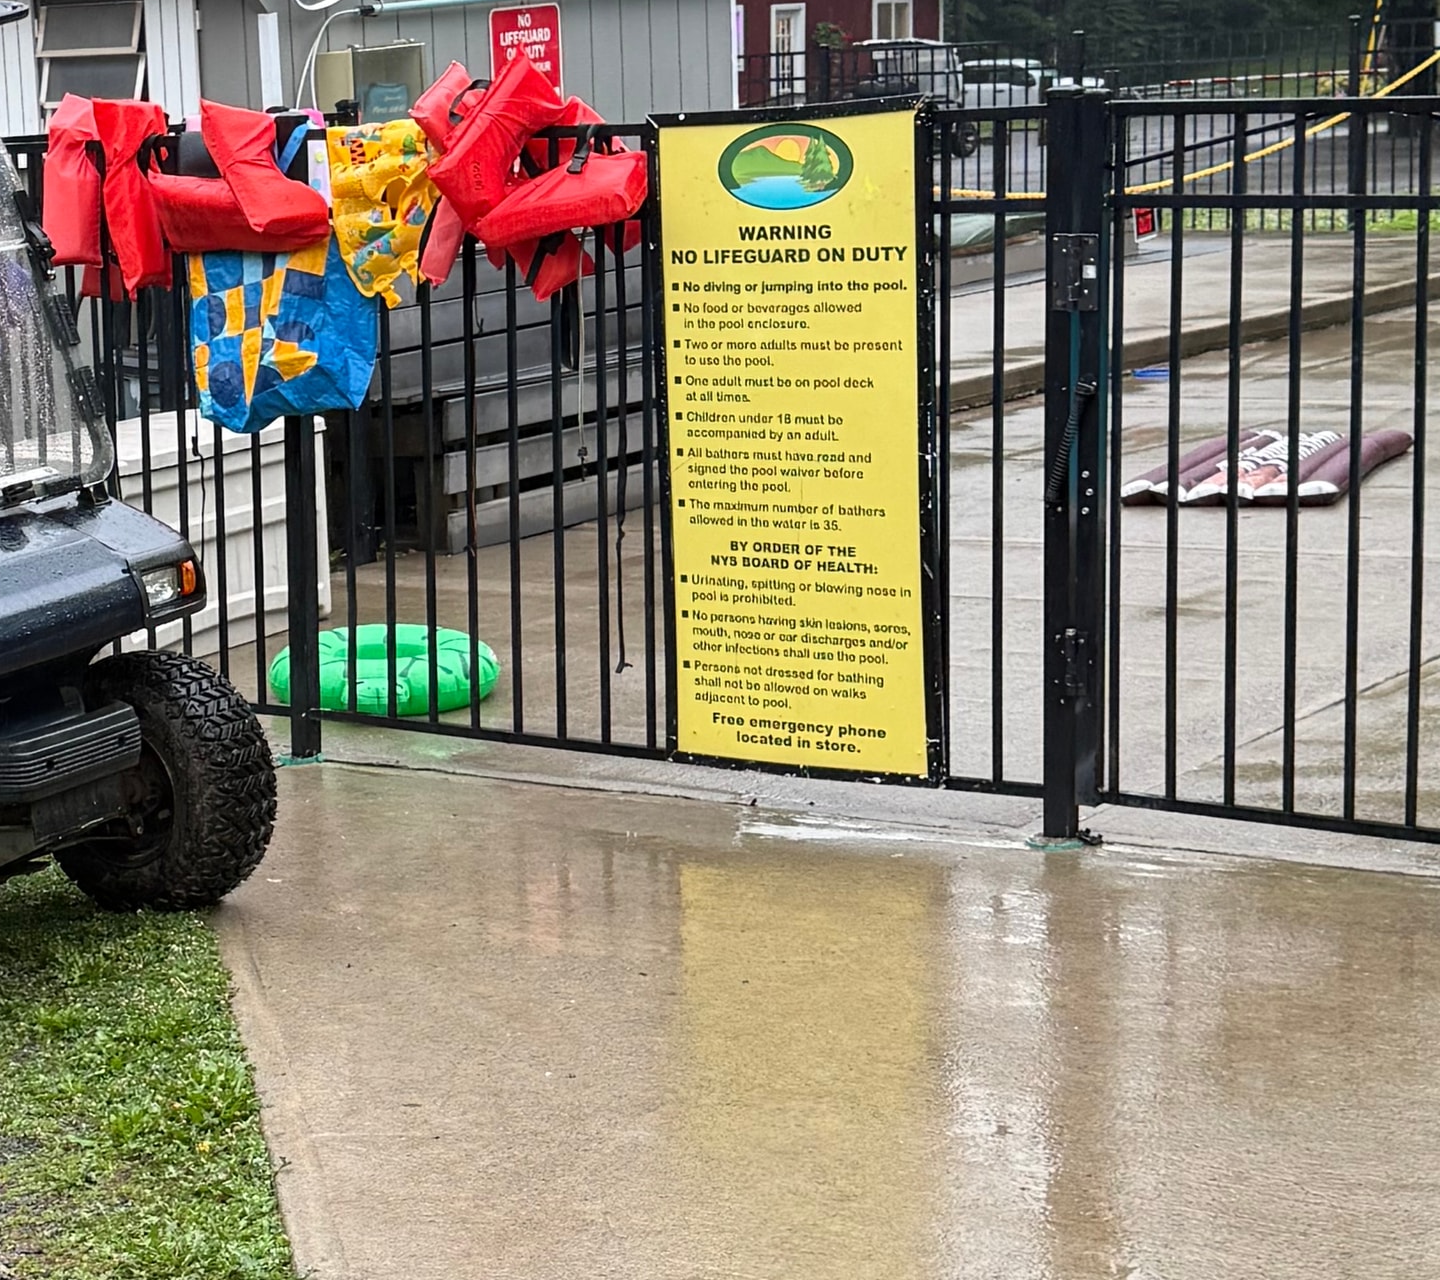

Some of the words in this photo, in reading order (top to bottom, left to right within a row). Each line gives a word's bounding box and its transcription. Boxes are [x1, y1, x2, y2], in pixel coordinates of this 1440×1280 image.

[517, 13, 532, 28] NO
[500, 27, 552, 47] LIFEGUARD
[738, 224, 832, 242] WARNING
[671, 249, 698, 265] NO
[703, 248, 811, 265] LIFEGUARD
[816, 247, 845, 263] ON
[852, 245, 908, 262] DUTY
[683, 281, 701, 293] No
[703, 281, 741, 295] diving
[744, 283, 759, 292] or
[760, 280, 814, 295] jumping
[817, 280, 844, 292] into
[847, 280, 869, 292] the
[873, 279, 908, 294] pool.
[683, 302, 700, 314] No
[702, 302, 729, 314] food
[731, 304, 744, 314] or
[747, 302, 810, 316] beverages
[813, 301, 862, 313] allowed
[684, 318, 695, 329] in
[697, 318, 716, 329] the
[718, 318, 744, 332] pool
[747, 318, 810, 329] enclosure.
[684, 338, 709, 350] Two
[710, 341, 723, 350] or
[726, 341, 757, 350] more
[760, 339, 798, 351] adults
[800, 340, 831, 351] must
[833, 339, 850, 351] be
[853, 339, 903, 353] present
[684, 354, 697, 366] to
[699, 356, 720, 366] use
[722, 354, 742, 366] the
[744, 355, 775, 368] pool.
[685, 375, 709, 387] One
[712, 375, 742, 387] adult
[744, 376, 775, 388] must
[776, 376, 792, 388] be
[794, 378, 810, 388] on
[813, 376, 841, 391] pool
[843, 376, 874, 389] deck
[685, 391, 698, 402] at
[699, 390, 713, 402] all
[686, 411, 736, 423] Children
[738, 412, 774, 424] under
[794, 414, 825, 426] must
[827, 414, 844, 426] be
[687, 428, 766, 441] accompanied
[769, 429, 784, 443] by
[786, 431, 802, 441] an
[687, 447, 703, 458] All
[705, 447, 750, 460] bathers
[752, 450, 783, 462] must
[785, 450, 814, 462] have
[816, 451, 845, 463] read
[848, 452, 872, 464] and
[687, 462, 727, 476] signed
[729, 464, 749, 476] the
[751, 465, 777, 478] pool
[779, 466, 821, 478] waiver
[823, 467, 864, 480] before
[688, 478, 737, 493] entering
[739, 479, 759, 492] the
[762, 481, 791, 494] pool.
[689, 498, 711, 510] The
[713, 500, 769, 513] maximum
[772, 503, 819, 515] number
[821, 503, 834, 515] of
[838, 504, 886, 518] bathers
[689, 514, 734, 526] allowed
[737, 516, 748, 527] in
[750, 516, 770, 528] the
[772, 519, 807, 530] water
[809, 519, 821, 530] is
[730, 540, 749, 552] BY
[752, 541, 801, 555] ORDER
[804, 544, 824, 556] OF
[826, 545, 857, 558] THE
[710, 554, 738, 567] NYS
[741, 556, 790, 570] BOARD
[793, 559, 813, 571] OF
[816, 560, 879, 575] HEALTH:
[691, 573, 748, 591] Urinating,
[751, 579, 796, 594] spitting
[798, 582, 812, 592] or
[814, 581, 863, 598] blowing
[866, 587, 897, 597] nose
[900, 587, 912, 598] in
[691, 590, 717, 603] pool
[719, 591, 730, 602] is
[732, 593, 796, 607] prohibited.
[692, 609, 708, 621] No
[710, 613, 756, 625] persons
[758, 614, 797, 630] having
[799, 617, 823, 629] skin
[825, 618, 871, 634] lesions,
[873, 624, 911, 637] sores,
[692, 626, 731, 640] mouth,
[733, 630, 761, 640] nose
[763, 632, 776, 641] or
[778, 633, 798, 643] ear
[800, 632, 866, 649] discharges
[869, 638, 909, 650] and/or
[692, 640, 723, 653] other
[725, 642, 780, 657] infections
[782, 646, 810, 659] shall
[812, 651, 834, 661] use
[836, 650, 856, 663] the
[858, 653, 889, 665] pool.
[694, 659, 741, 675] Persons
[743, 665, 763, 676] not
[765, 666, 814, 680] dressed
[816, 669, 834, 681] for
[837, 671, 884, 689] bathing
[694, 675, 722, 688] shall
[724, 679, 744, 690] not
[745, 679, 761, 691] be
[763, 681, 810, 695] allowed
[812, 687, 829, 697] on
[830, 687, 867, 700] walks
[694, 691, 746, 706] adjacent
[748, 694, 760, 706] to
[762, 698, 792, 710] pool.
[712, 711, 745, 727] Free
[749, 718, 834, 738] emergency
[838, 723, 887, 739] phone
[736, 730, 792, 747] located
[797, 735, 811, 749] in
[815, 739, 861, 754] store.
